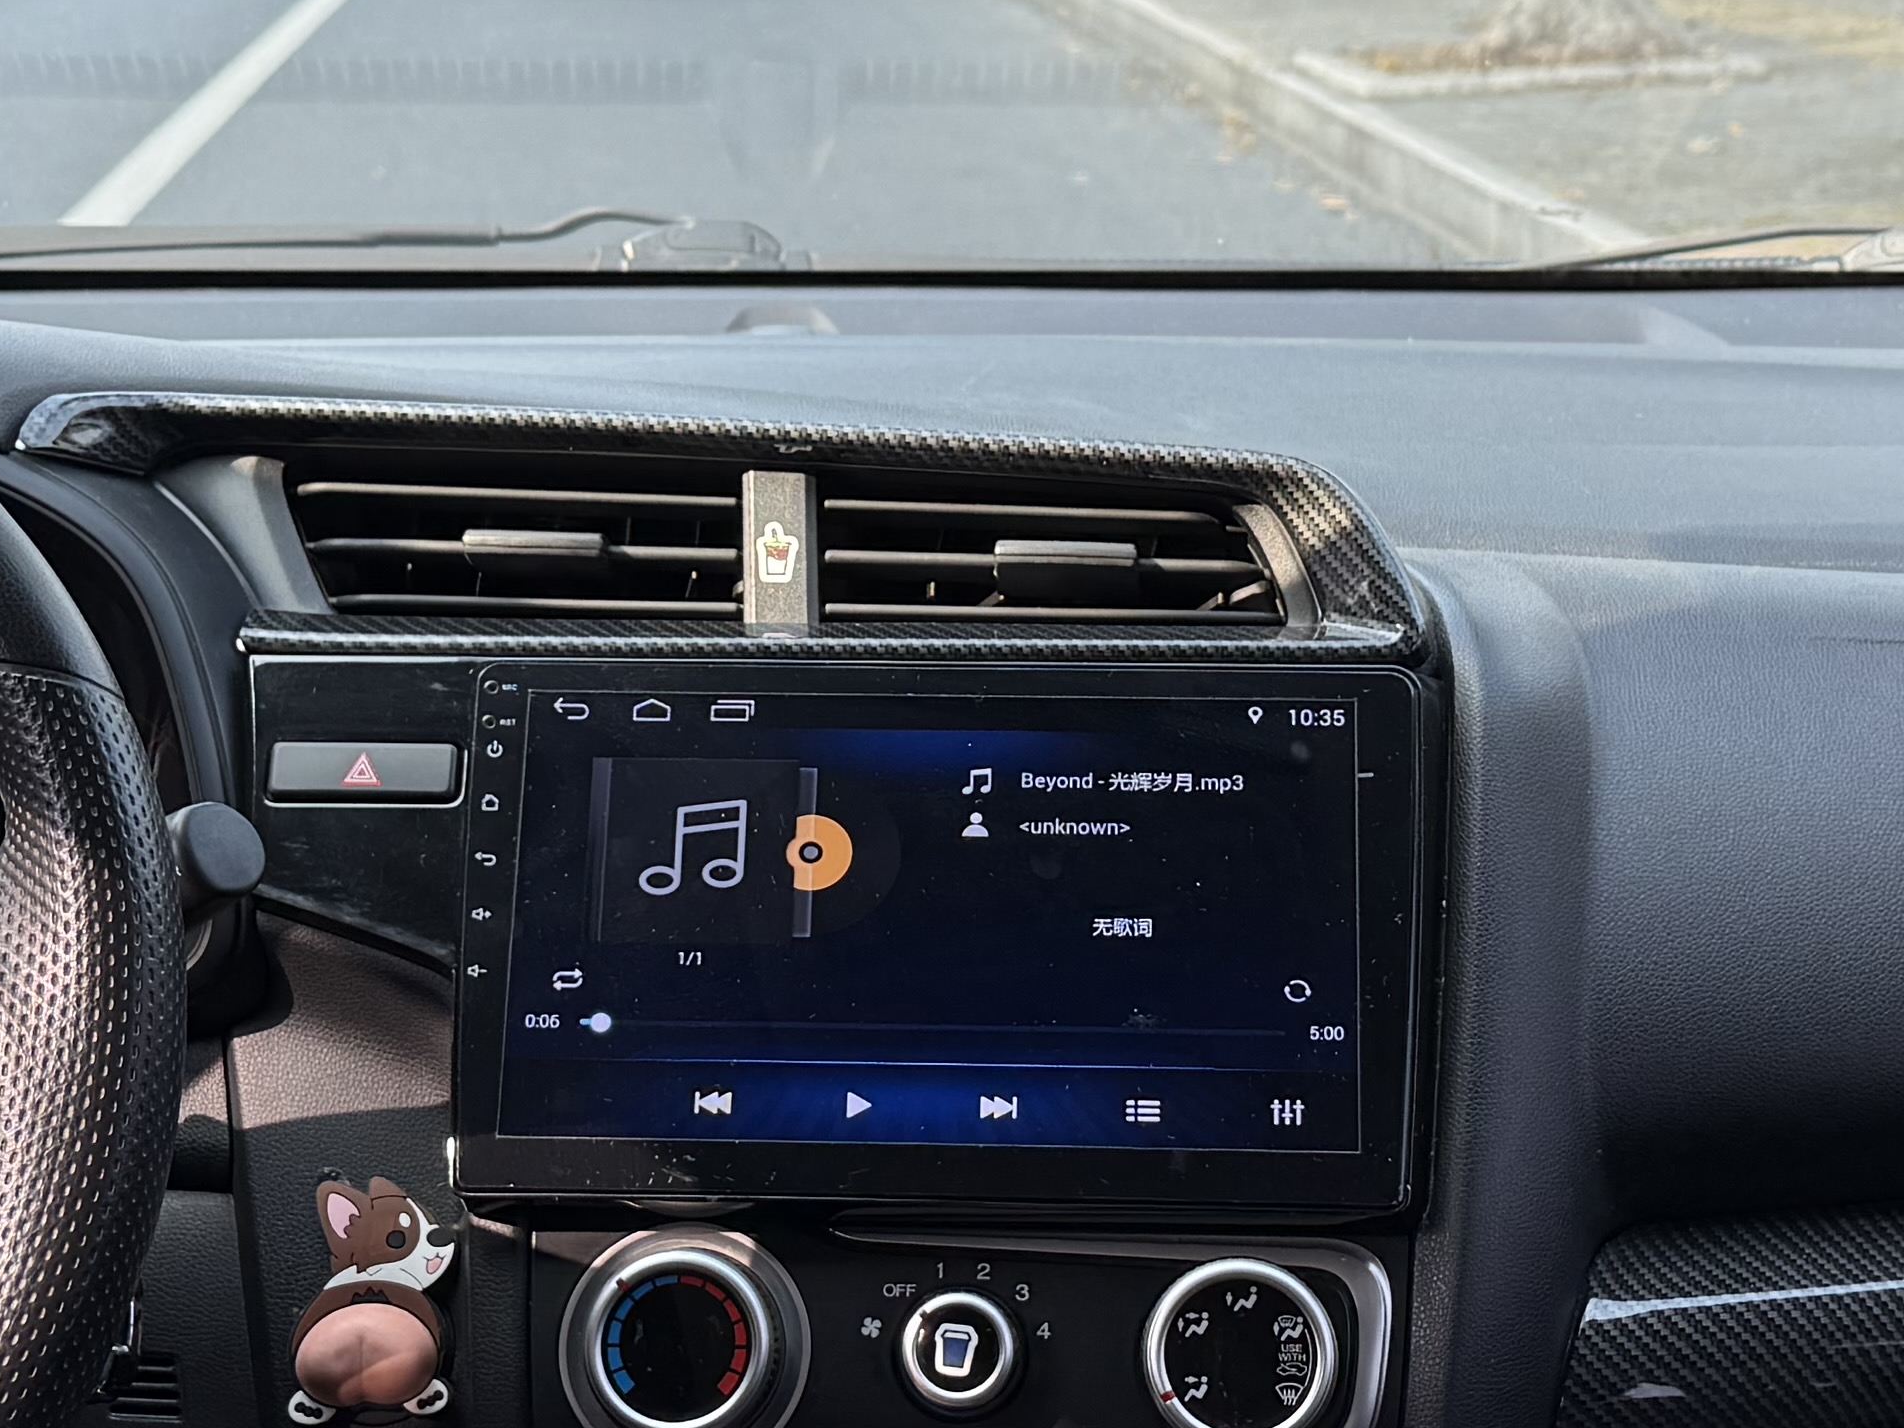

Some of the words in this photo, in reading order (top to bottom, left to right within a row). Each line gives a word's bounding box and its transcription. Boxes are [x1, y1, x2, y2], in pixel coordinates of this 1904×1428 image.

[1287, 708, 1345, 727] 10:35
[1021, 773, 1094, 793] Beyond
[1108, 772, 1244, 794] 光辉岁月.mp3
[1019, 817, 1130, 837] <unknown>
[1091, 918, 1153, 937] 无歌词
[678, 952, 702, 966] 1/1
[524, 1013, 560, 1029] 0:06
[1309, 1026, 1344, 1041] 5:00
[937, 1263, 944, 1279] 1
[976, 1264, 990, 1280] 2
[883, 1283, 916, 1299] OFF
[1015, 1284, 1030, 1301] 3
[1036, 1323, 1051, 1339] 4
[1281, 1343, 1303, 1352] USE
[1278, 1352, 1307, 1363] WITH
